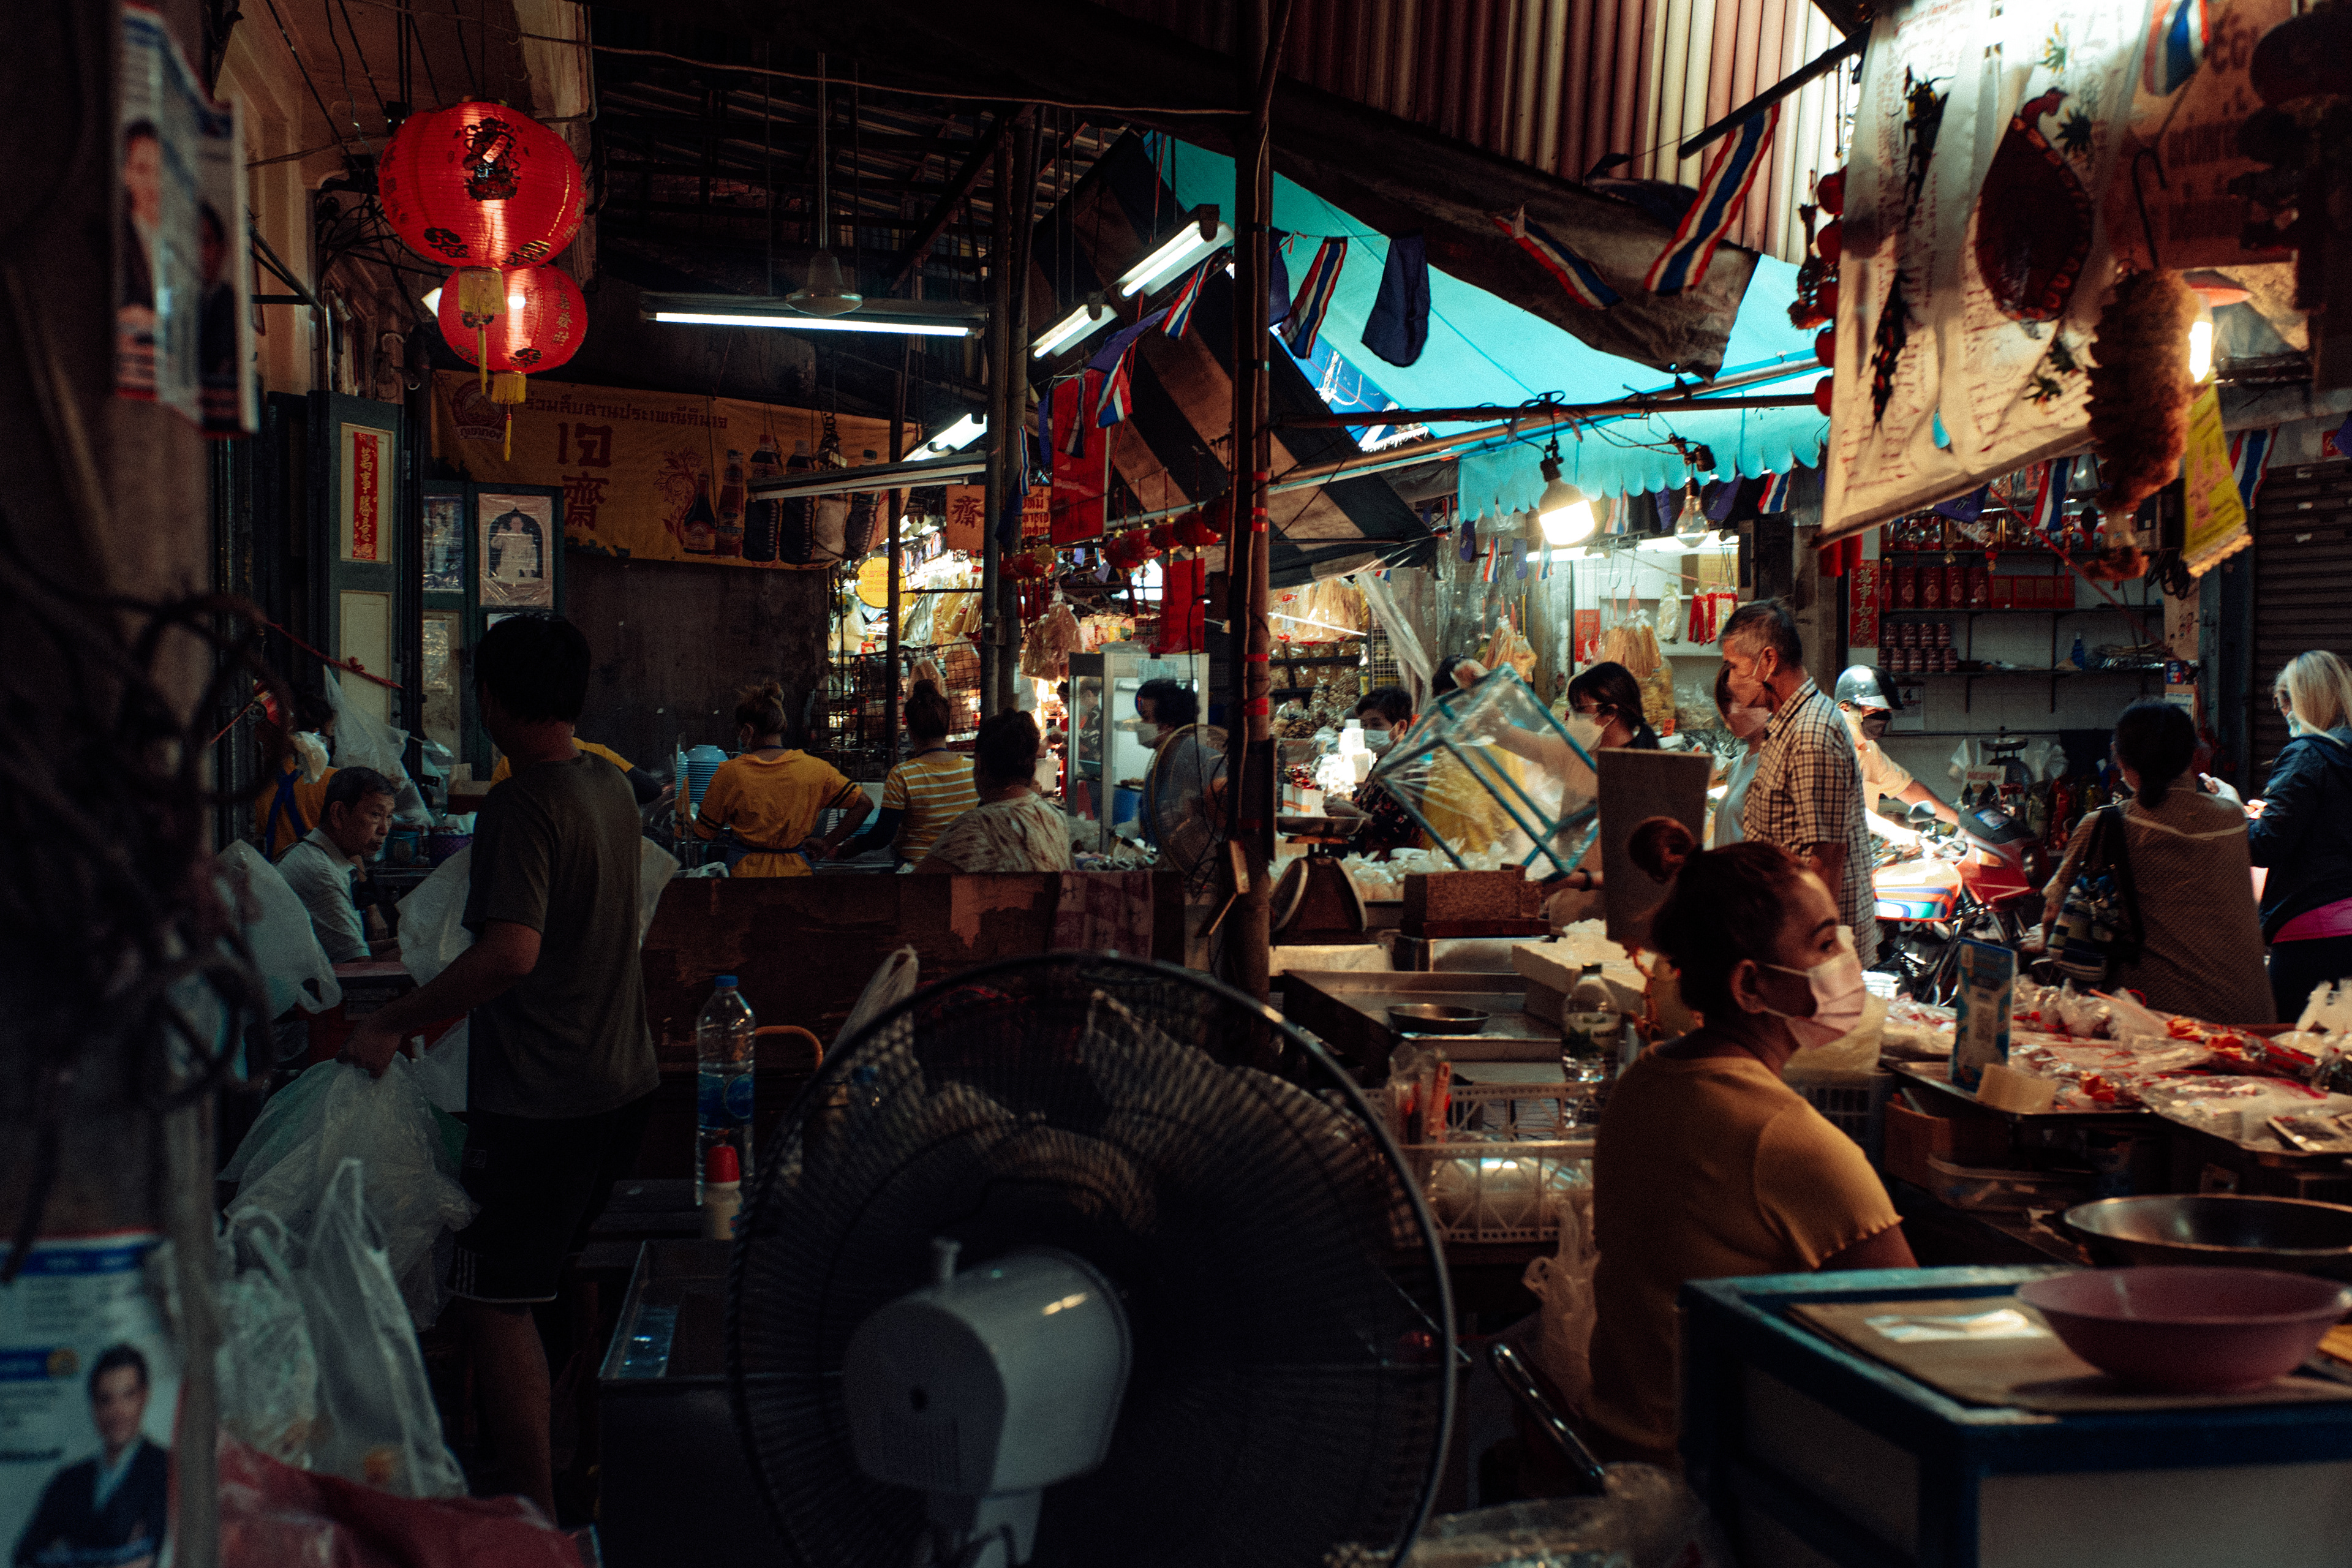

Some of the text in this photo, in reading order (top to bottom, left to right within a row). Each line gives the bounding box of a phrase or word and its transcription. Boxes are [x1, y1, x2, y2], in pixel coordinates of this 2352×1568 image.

[557, 422, 612, 467] เจ
[562, 471, 609, 530] 齋
[1856, 568, 1873, 634] 萬事如意
[1904, 690, 1912, 701] 4
